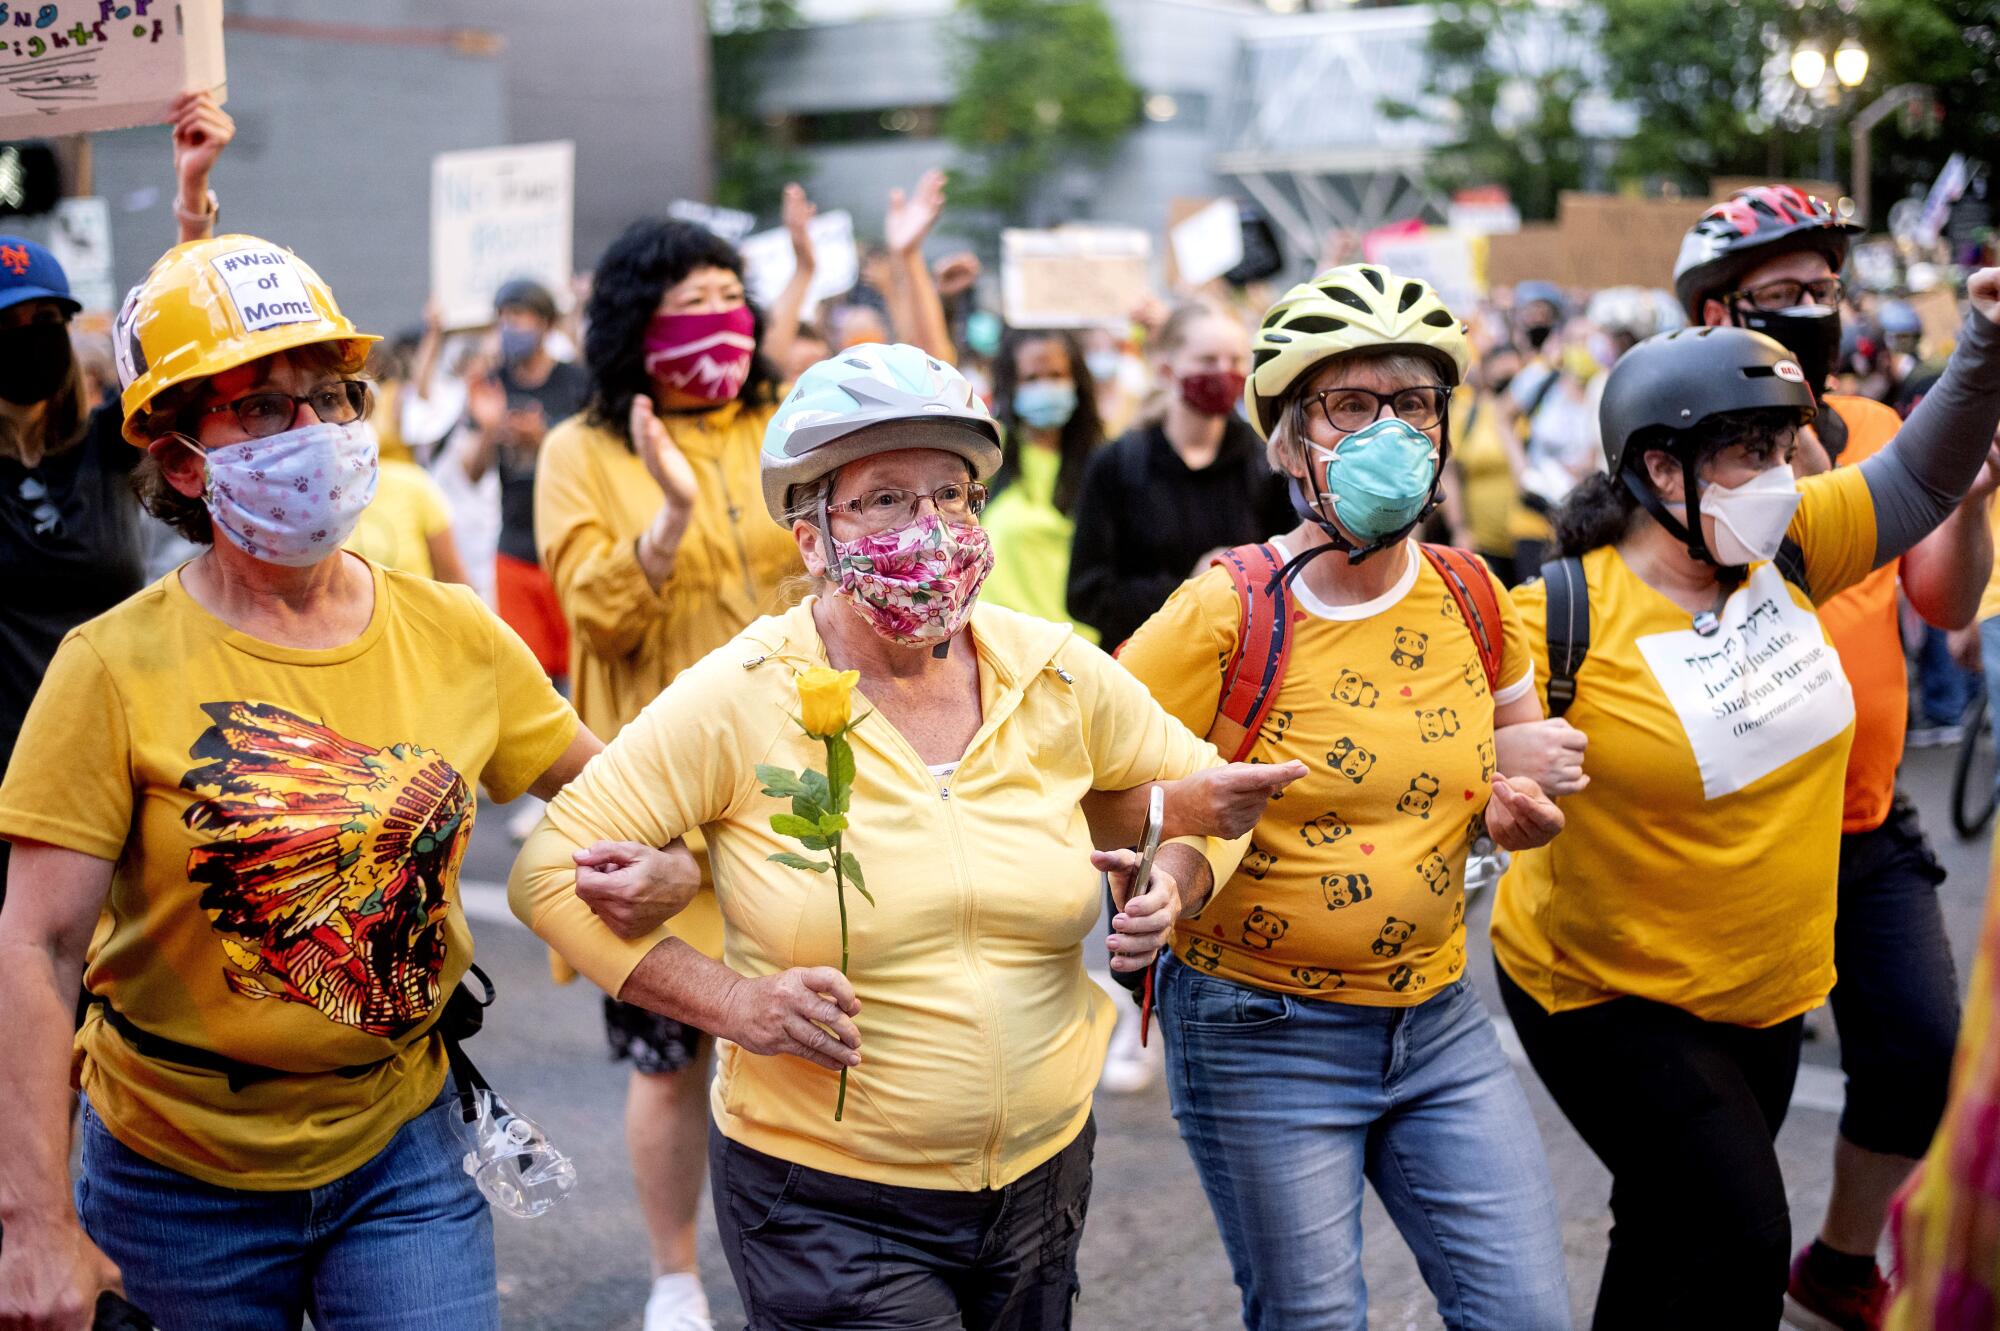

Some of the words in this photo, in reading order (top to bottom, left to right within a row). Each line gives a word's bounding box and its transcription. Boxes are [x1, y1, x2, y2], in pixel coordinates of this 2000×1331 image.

[224, 252, 285, 271] #Wall
[257, 272, 279, 290] of
[243, 301, 312, 323] Moms
[1749, 682, 1776, 707] you
[1772, 647, 1825, 687] Pursue
